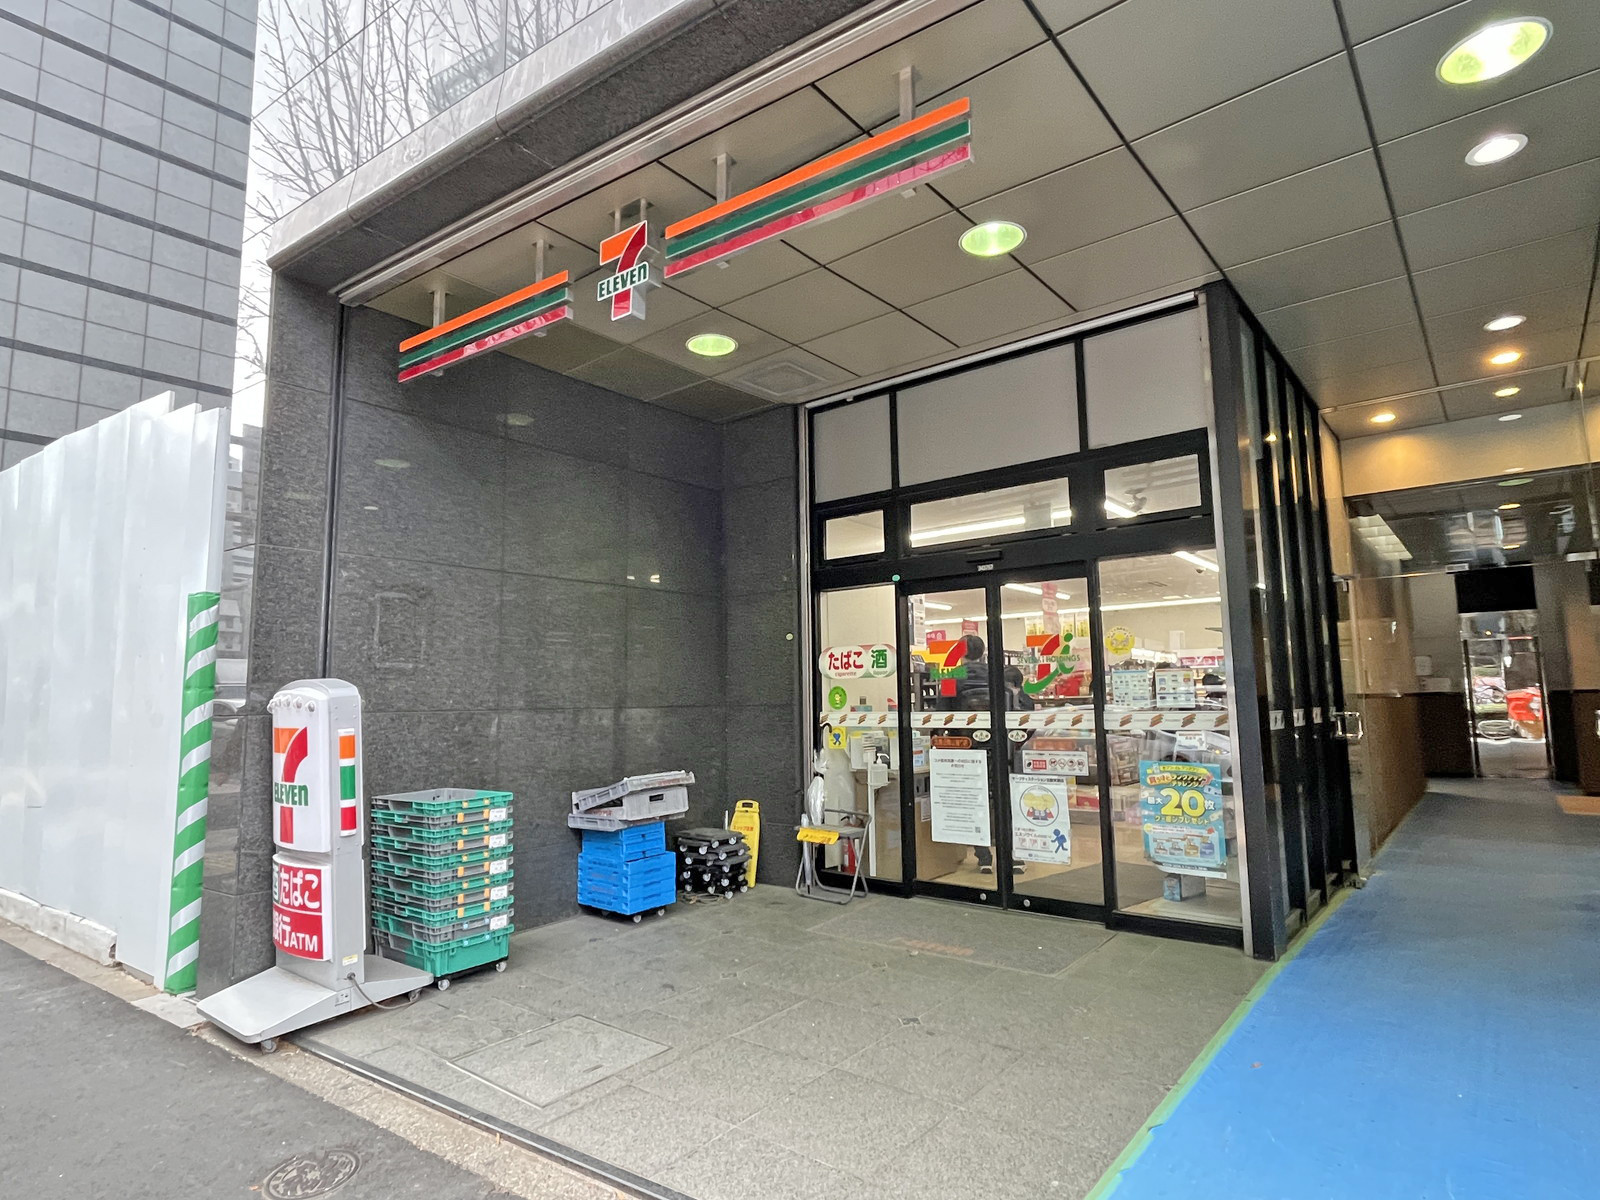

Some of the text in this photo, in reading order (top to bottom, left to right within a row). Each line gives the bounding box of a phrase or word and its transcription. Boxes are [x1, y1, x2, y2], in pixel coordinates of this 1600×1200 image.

[600, 220, 647, 320] 7
[828, 648, 887, 671] たばこ 酒
[274, 727, 308, 844] 7
[280, 867, 320, 909] たばこ
